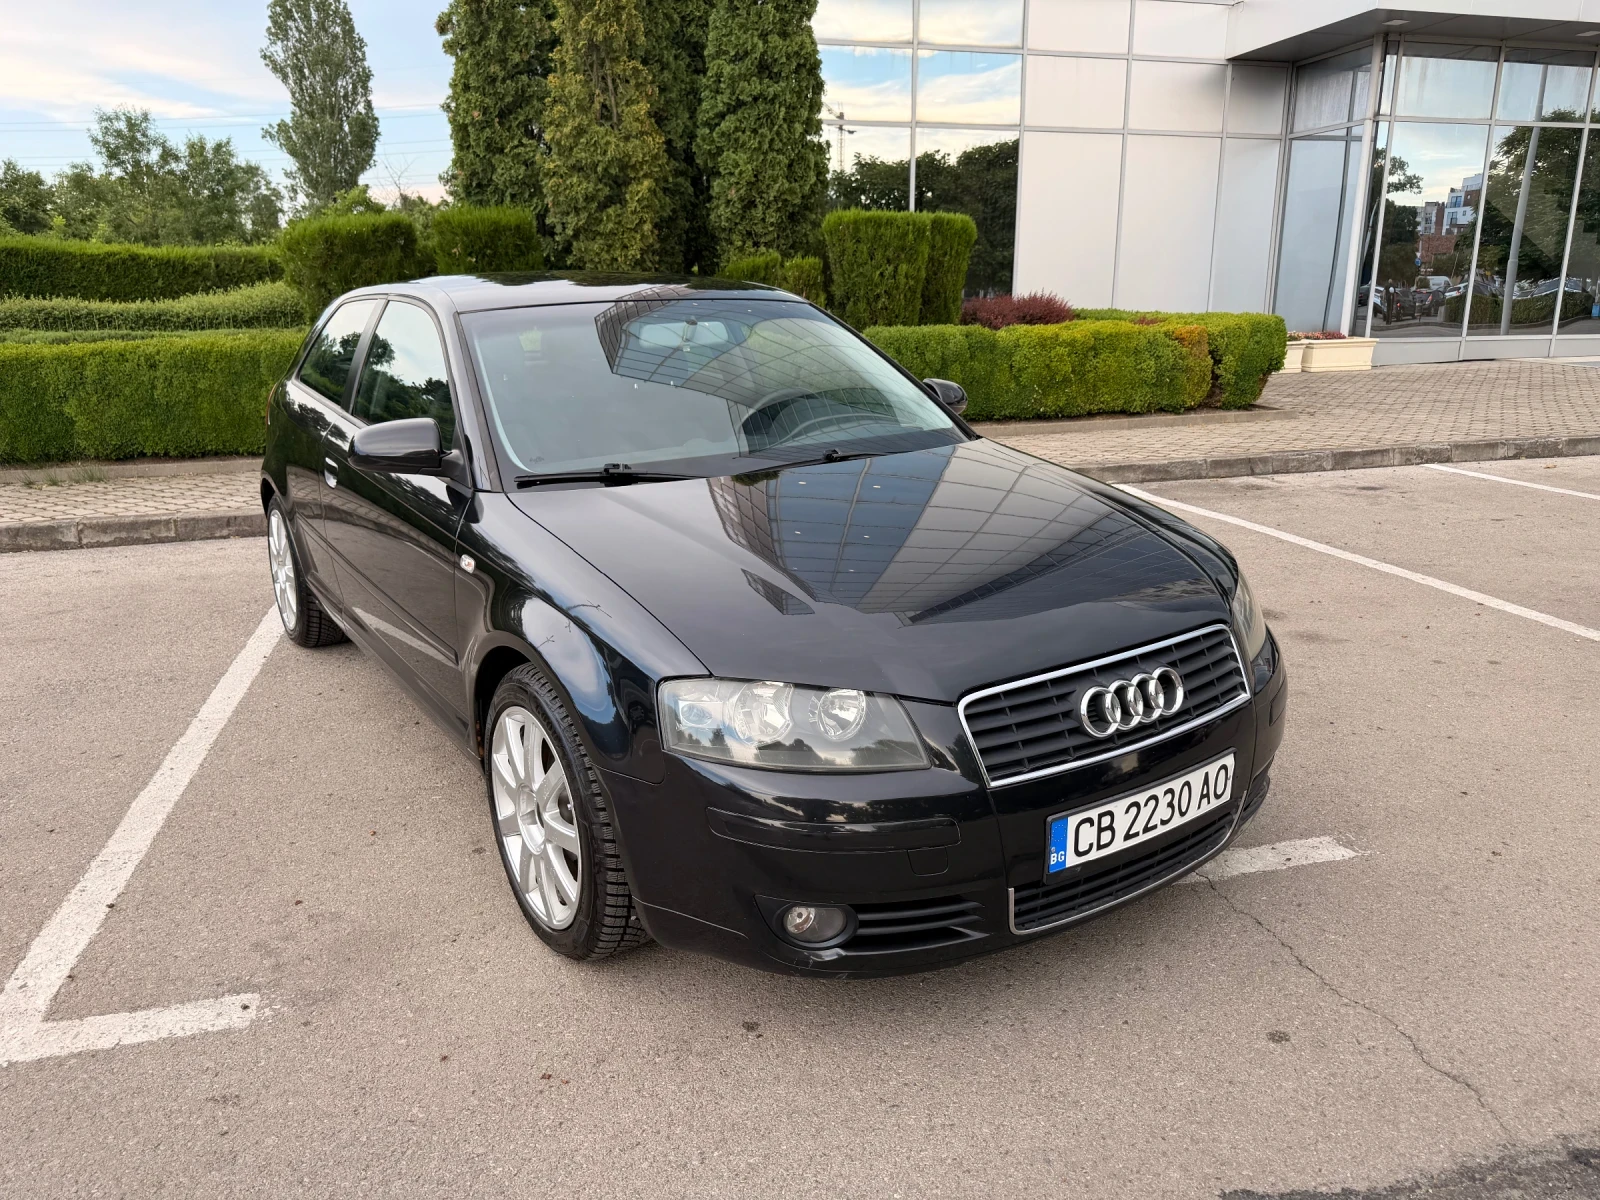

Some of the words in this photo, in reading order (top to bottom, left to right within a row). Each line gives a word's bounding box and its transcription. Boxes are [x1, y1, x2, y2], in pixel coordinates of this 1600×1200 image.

[1073, 810, 1116, 857] CB
[1123, 780, 1192, 842] 2230
[1197, 764, 1229, 810] AO
[1050, 851, 1065, 865] BG
